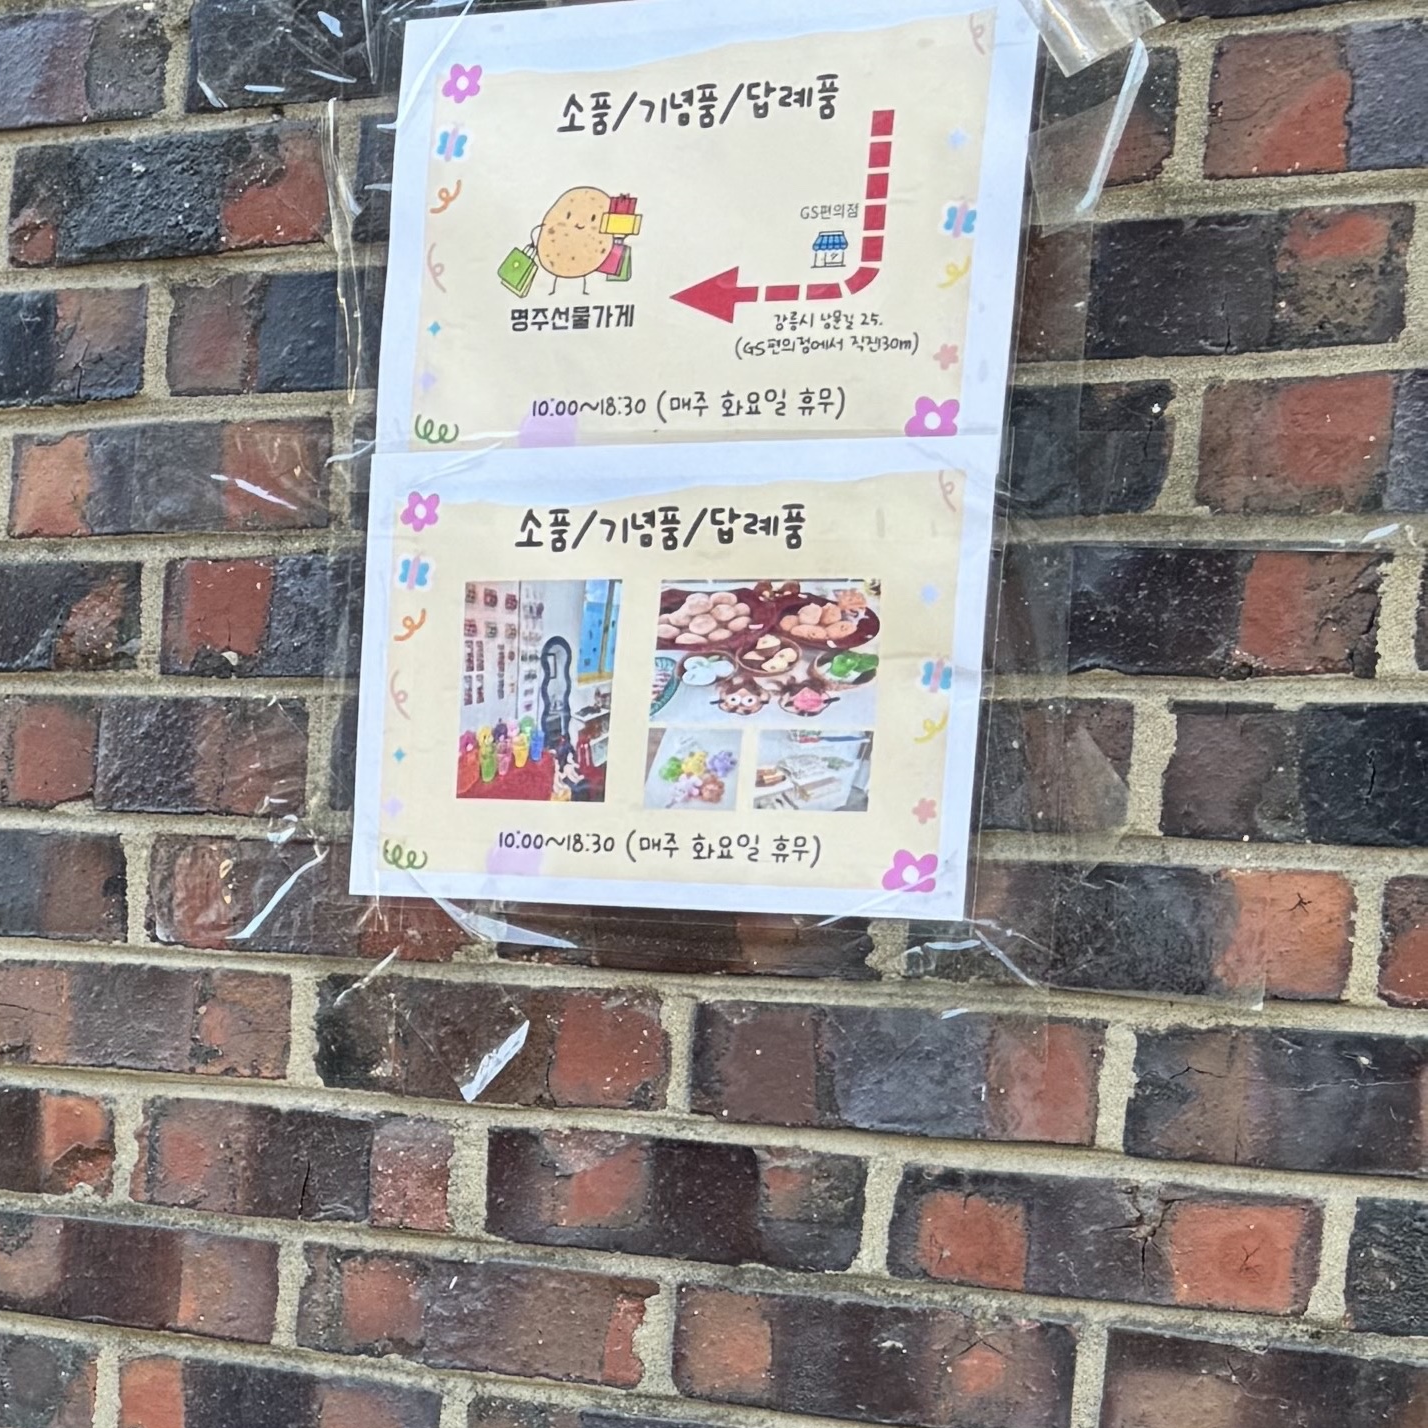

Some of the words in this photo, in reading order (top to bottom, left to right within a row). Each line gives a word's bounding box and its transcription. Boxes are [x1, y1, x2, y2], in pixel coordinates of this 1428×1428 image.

[799, 202, 860, 220] GS편의점
[510, 303, 636, 332] 명주선물가게
[773, 310, 815, 331] 강릉시
[532, 396, 647, 417] 10:00~18:30
[656, 389, 709, 424] (매주
[721, 389, 787, 418] 화요일
[797, 386, 846, 421] 휴무)
[498, 830, 616, 854] 10:00~18:30
[626, 829, 680, 863] (매주
[691, 833, 760, 863] 화요일
[770, 834, 822, 869] 휴무)
